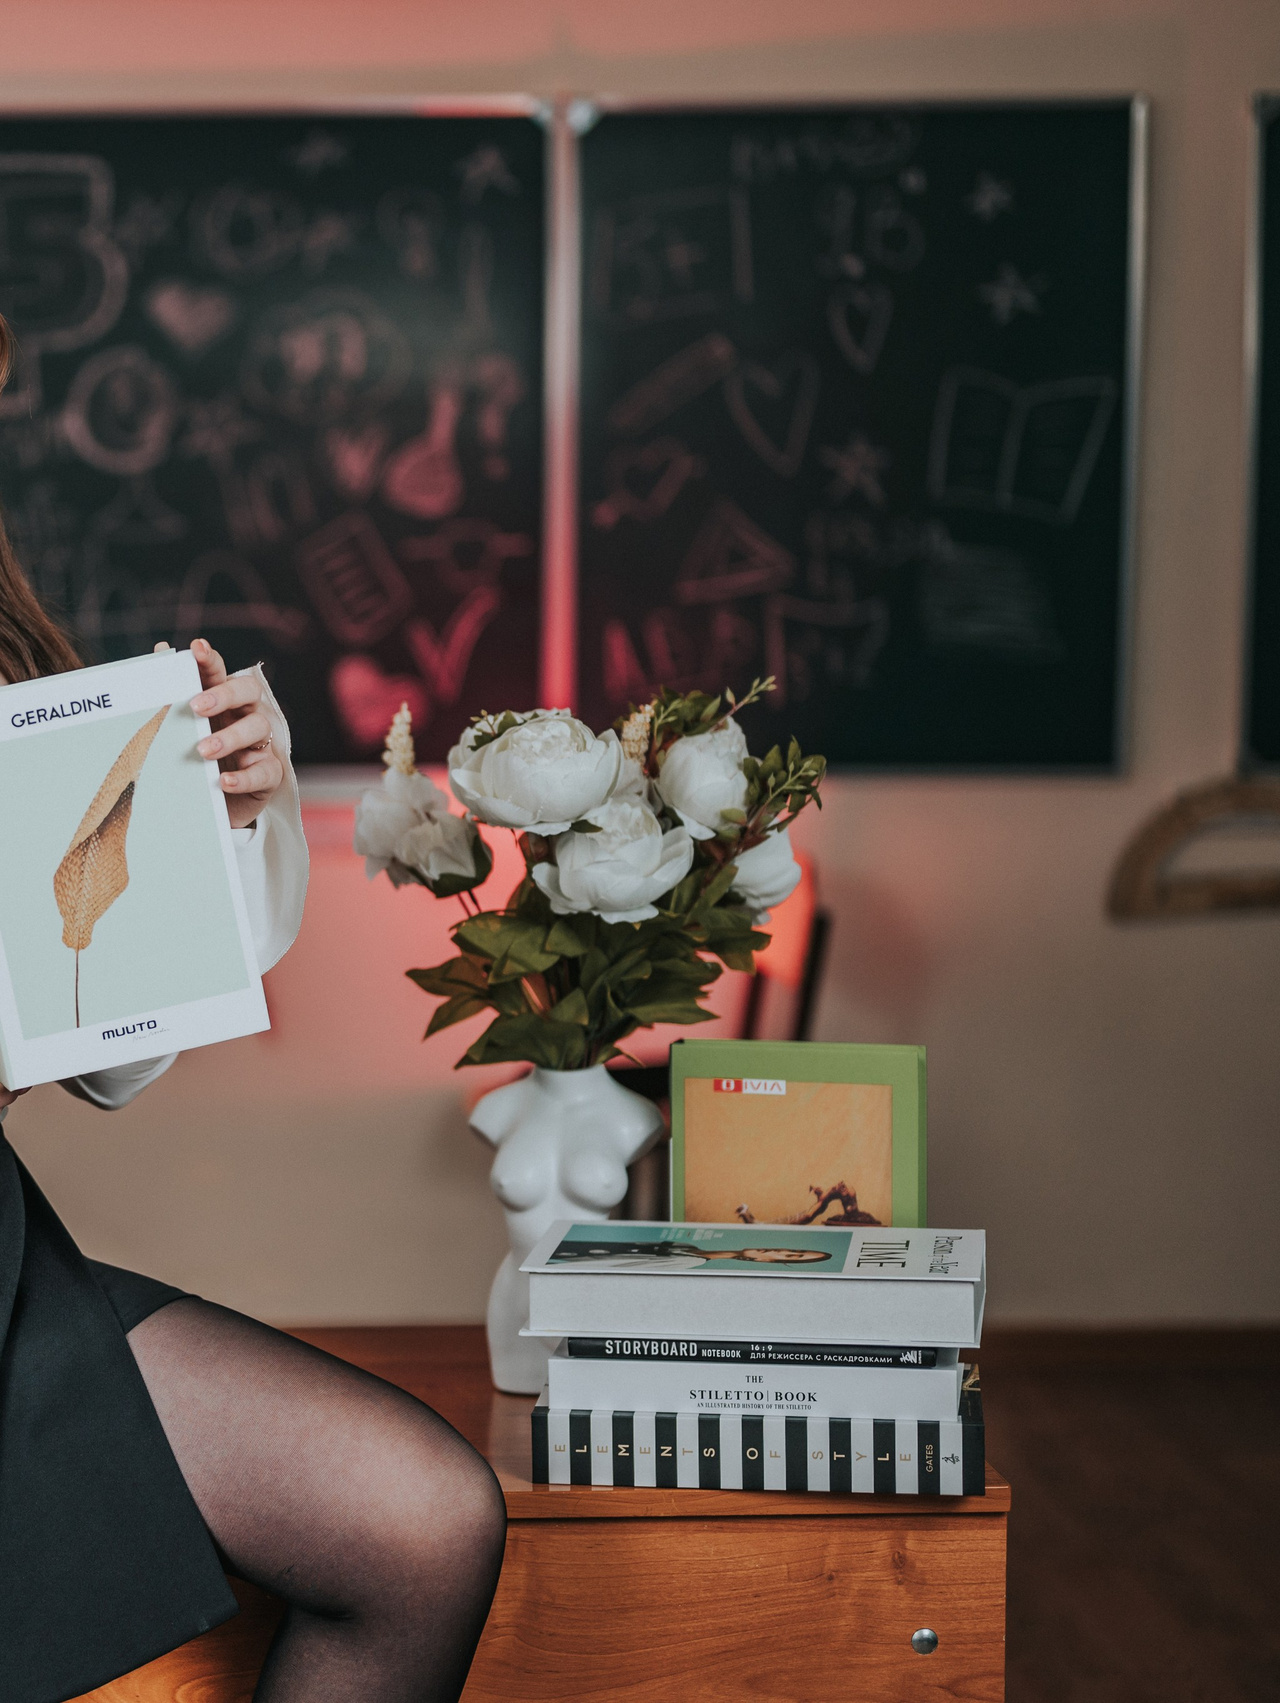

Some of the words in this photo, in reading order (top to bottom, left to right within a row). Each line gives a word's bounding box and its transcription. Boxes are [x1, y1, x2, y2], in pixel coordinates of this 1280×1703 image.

[11, 693, 112, 727] GERALDINE
[102, 1020, 157, 1041] MUUTO
[856, 1240, 910, 1268] TIME
[605, 1340, 698, 1357] STORYBOARD
[701, 1349, 741, 1359] NOTEBOOK
[750, 1352, 766, 1360] ДЛЯ
[768, 1353, 814, 1361] РЕЖИССЕРА
[823, 1355, 893, 1364] РАСКАДРОВКАМИ
[745, 1375, 764, 1384] THE
[689, 1389, 764, 1401] STILETTO
[774, 1391, 817, 1402] BOOK
[554, 1444, 716, 1458] ELEMENTS
[811, 1450, 912, 1462] STYLE
[925, 1444, 934, 1473] GATES
